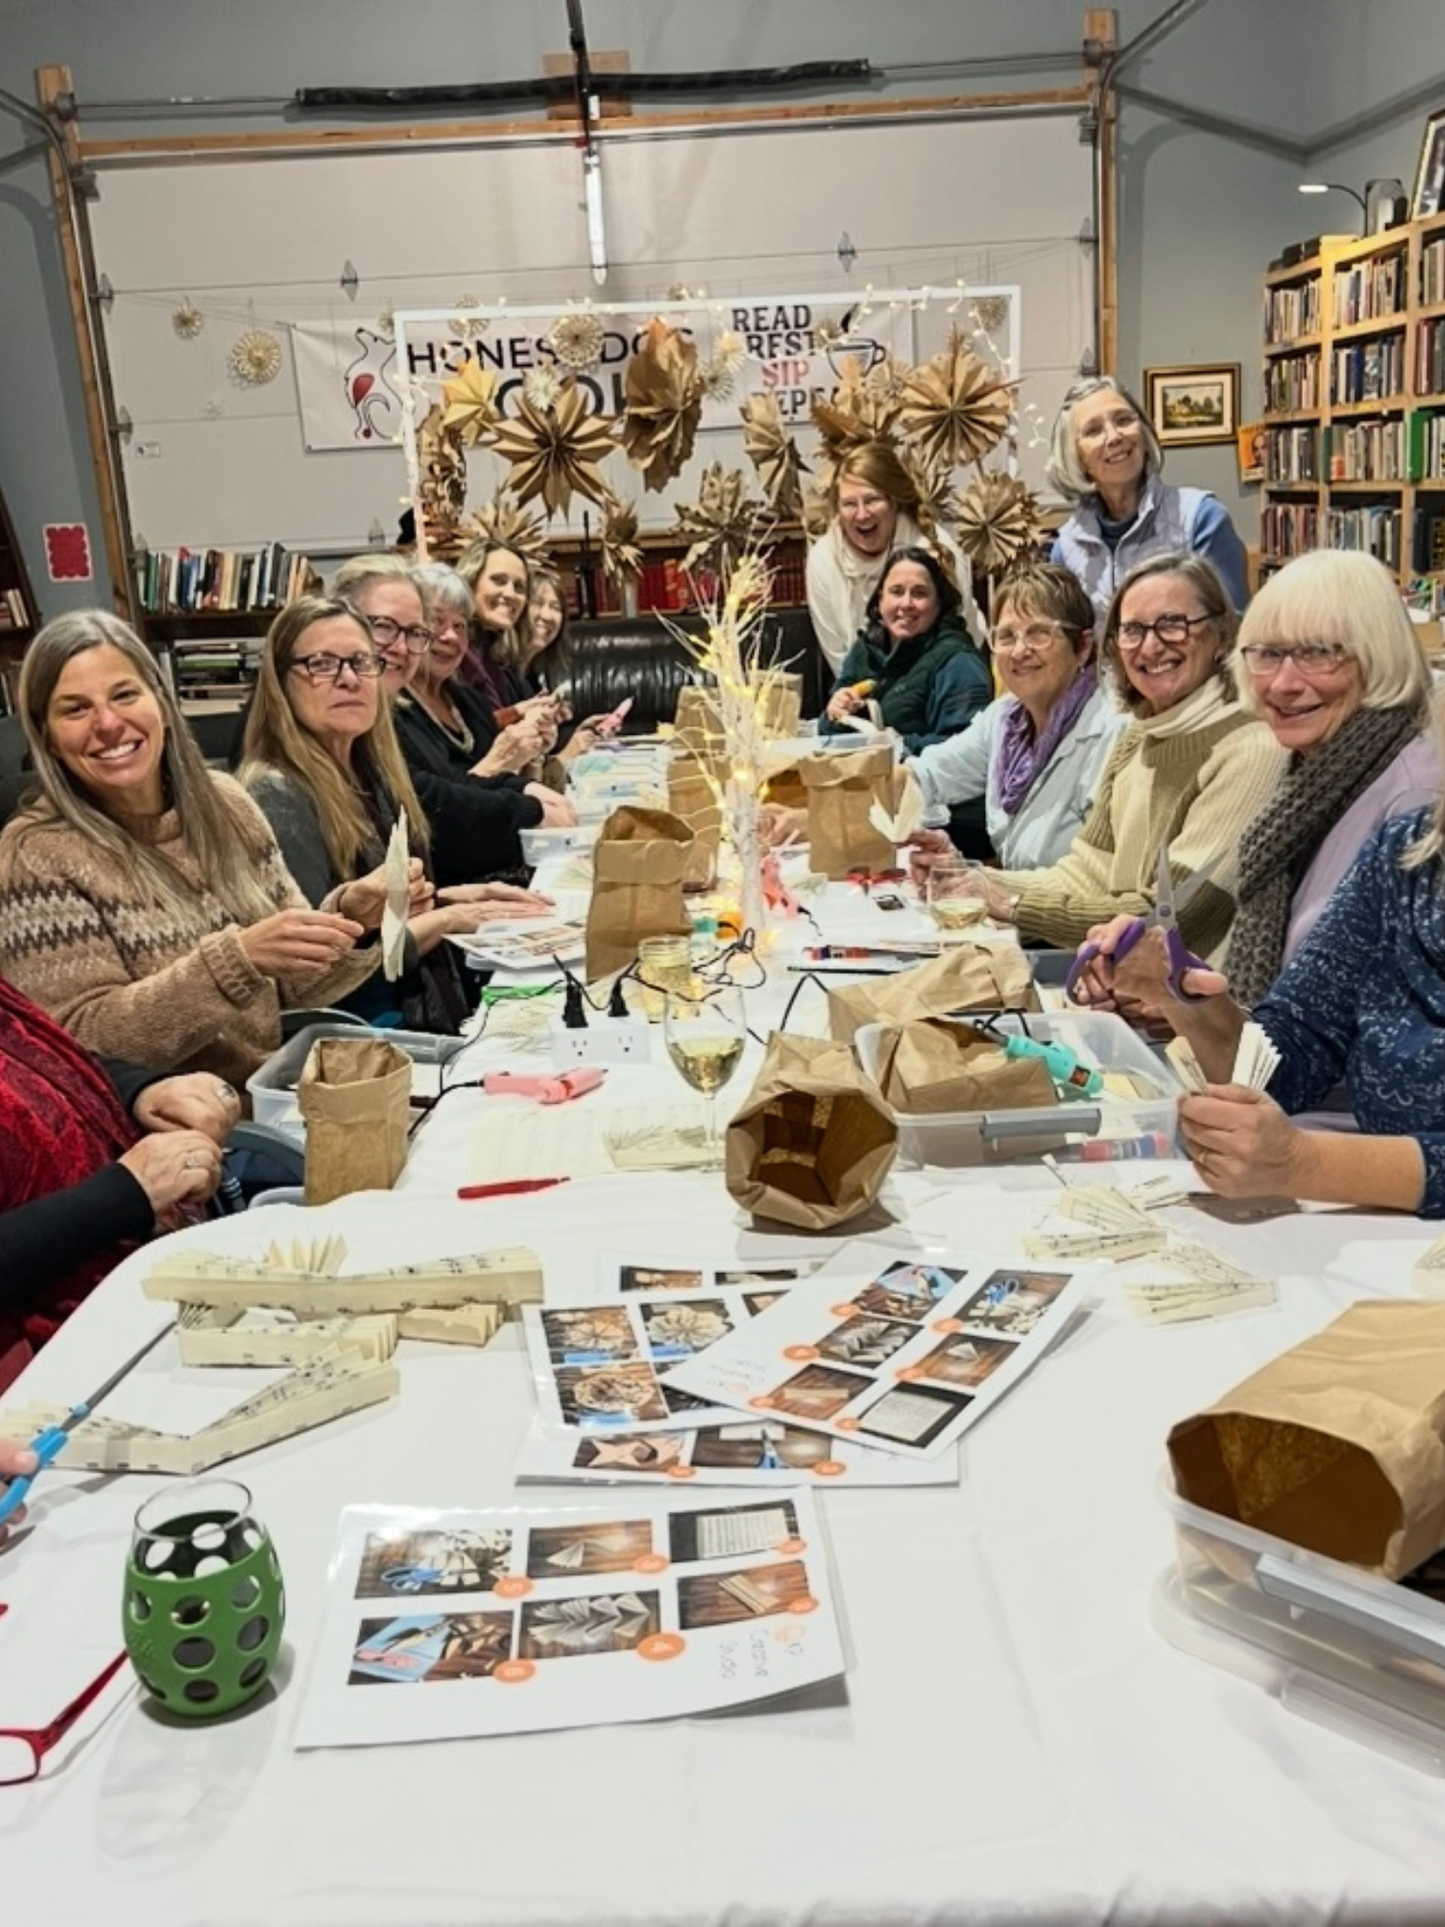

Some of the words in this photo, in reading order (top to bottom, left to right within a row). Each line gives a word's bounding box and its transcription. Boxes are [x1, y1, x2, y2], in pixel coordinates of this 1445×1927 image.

[732, 305, 811, 332] READ
[407, 337, 564, 374] HONES
[762, 361, 809, 387] SIP
